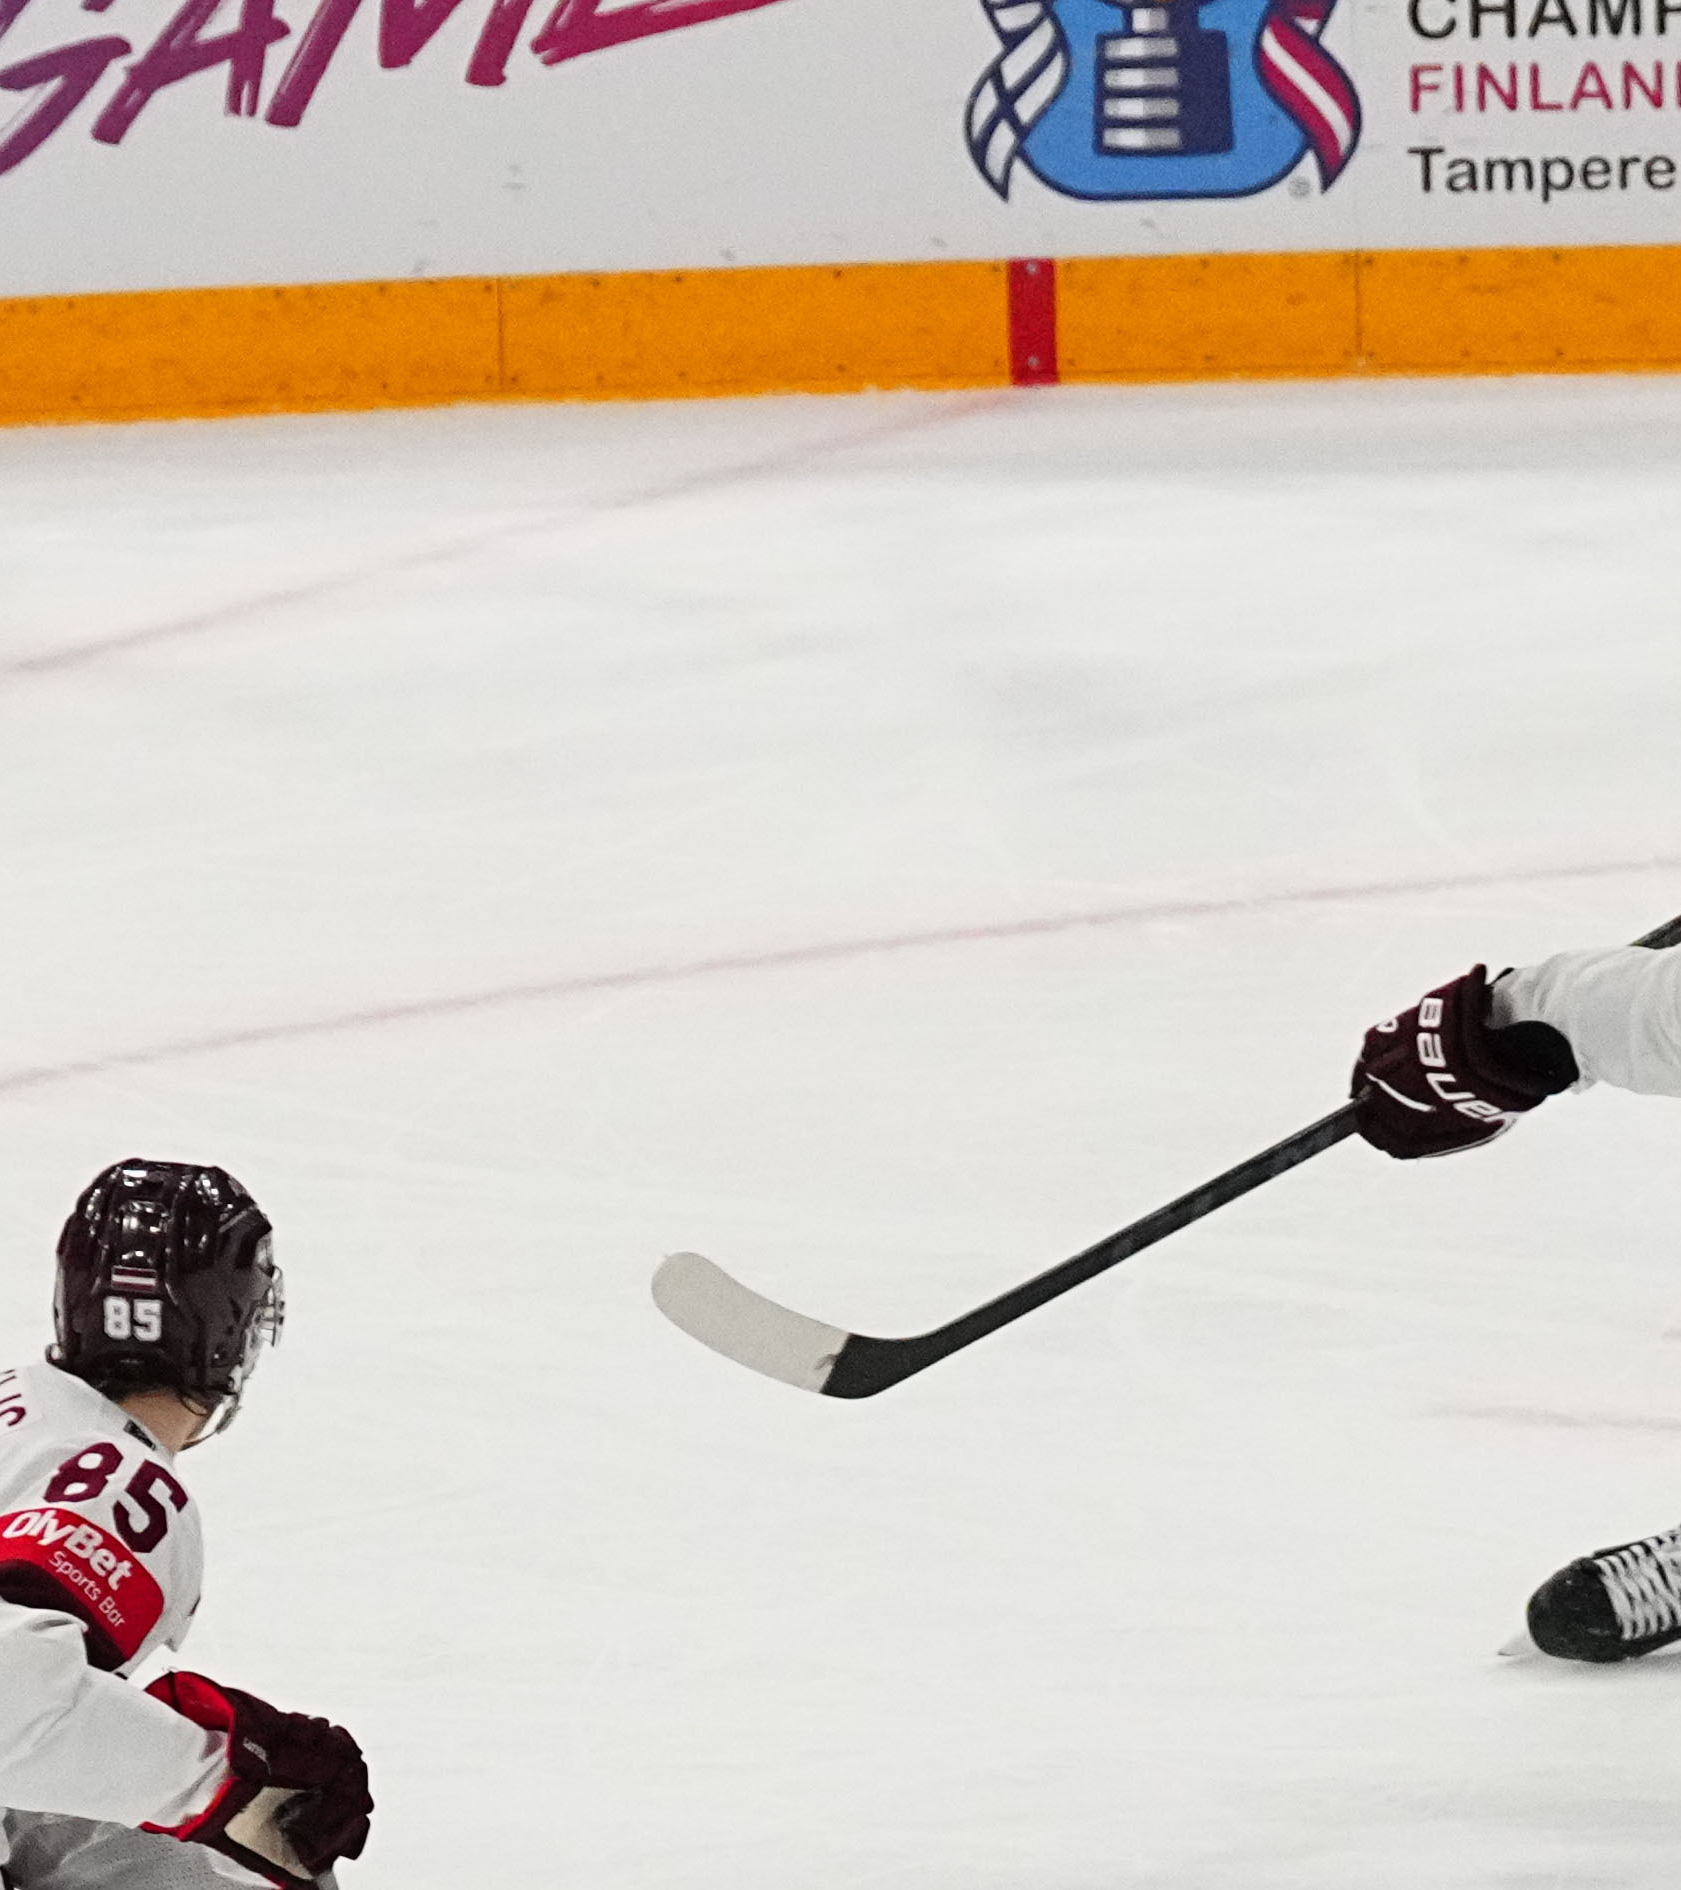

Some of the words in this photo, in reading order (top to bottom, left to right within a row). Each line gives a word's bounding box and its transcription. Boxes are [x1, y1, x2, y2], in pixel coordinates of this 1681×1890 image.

[1407, 146, 1677, 203] Tampere
[102, 1295, 164, 1342] 85
[42, 1441, 190, 1554] 85
[1, 1508, 135, 1592] OlyBet
[47, 1550, 103, 1602] Sports
[97, 1595, 127, 1629] Bar
